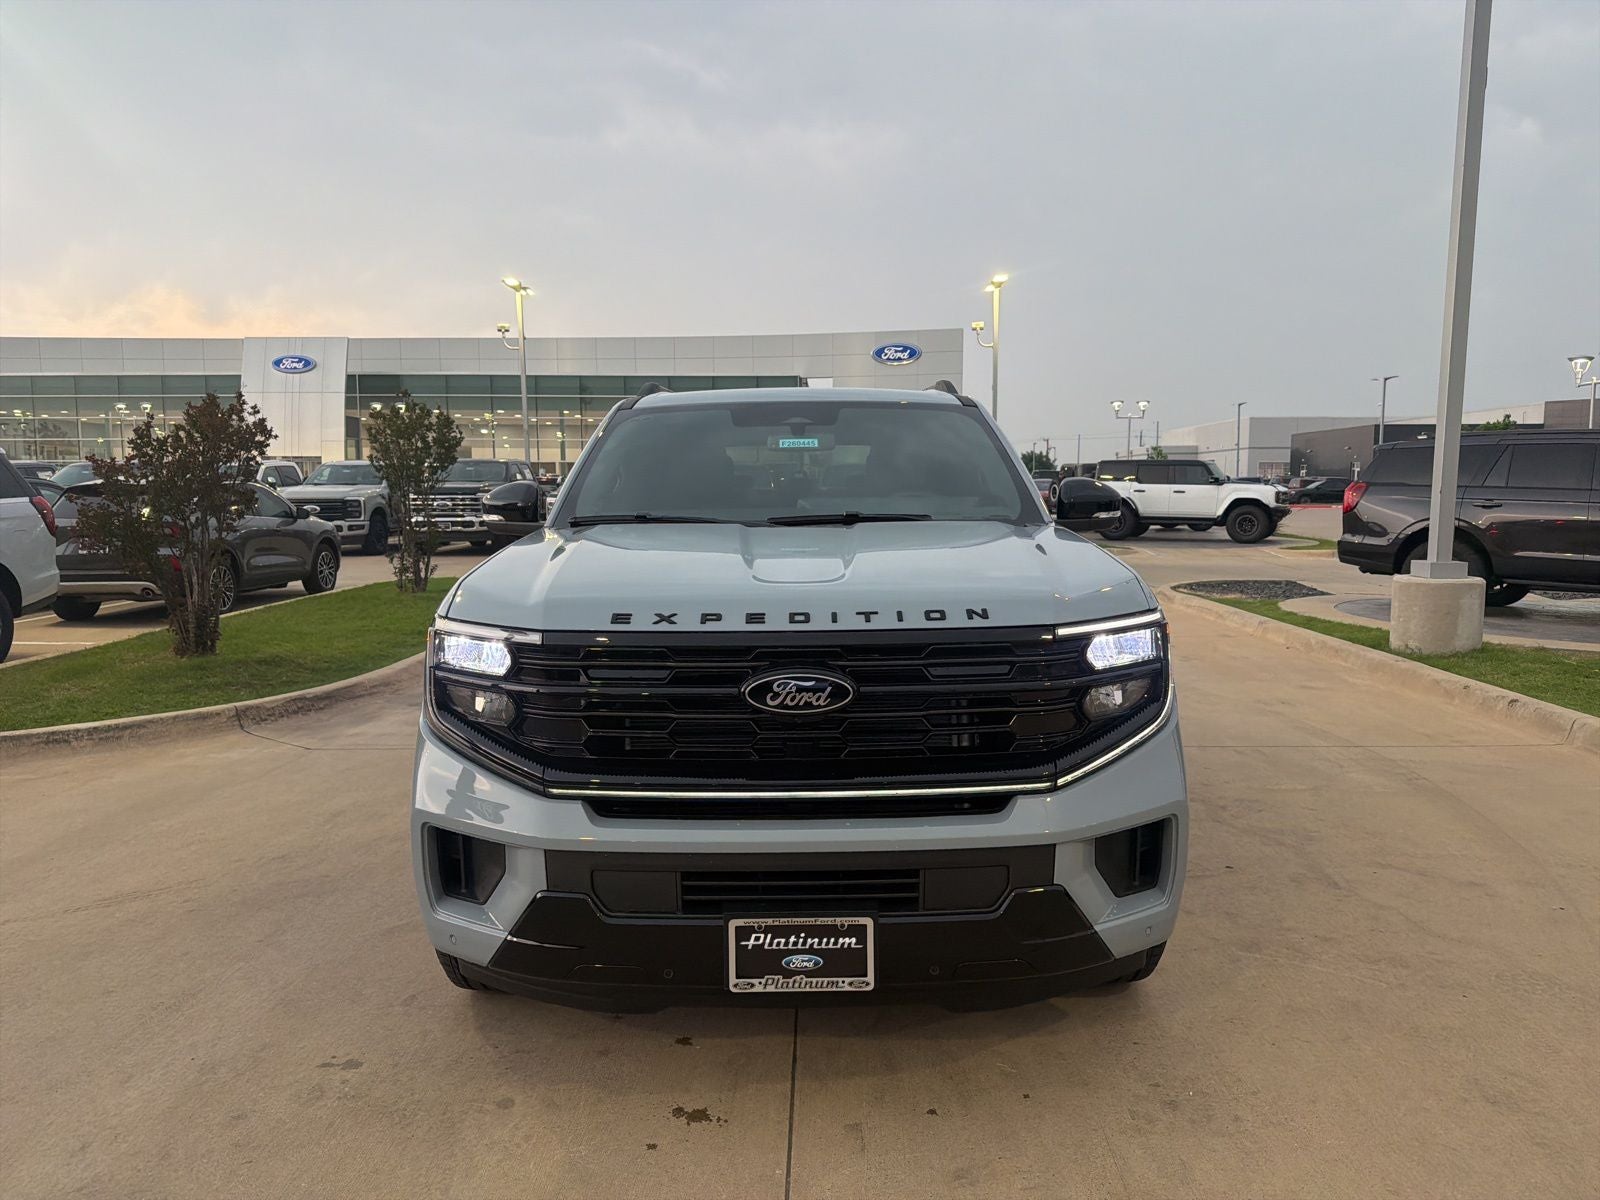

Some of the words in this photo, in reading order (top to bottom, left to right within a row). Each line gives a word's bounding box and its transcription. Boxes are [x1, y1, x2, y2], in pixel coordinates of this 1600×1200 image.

[882, 347, 910, 359] Ford
[280, 358, 304, 369] Ford
[610, 607, 990, 625] EXPEDITION
[766, 679, 831, 707] Ford
[739, 932, 864, 950] Platinum
[789, 957, 815, 968] Ford
[763, 976, 846, 990] Platinum
